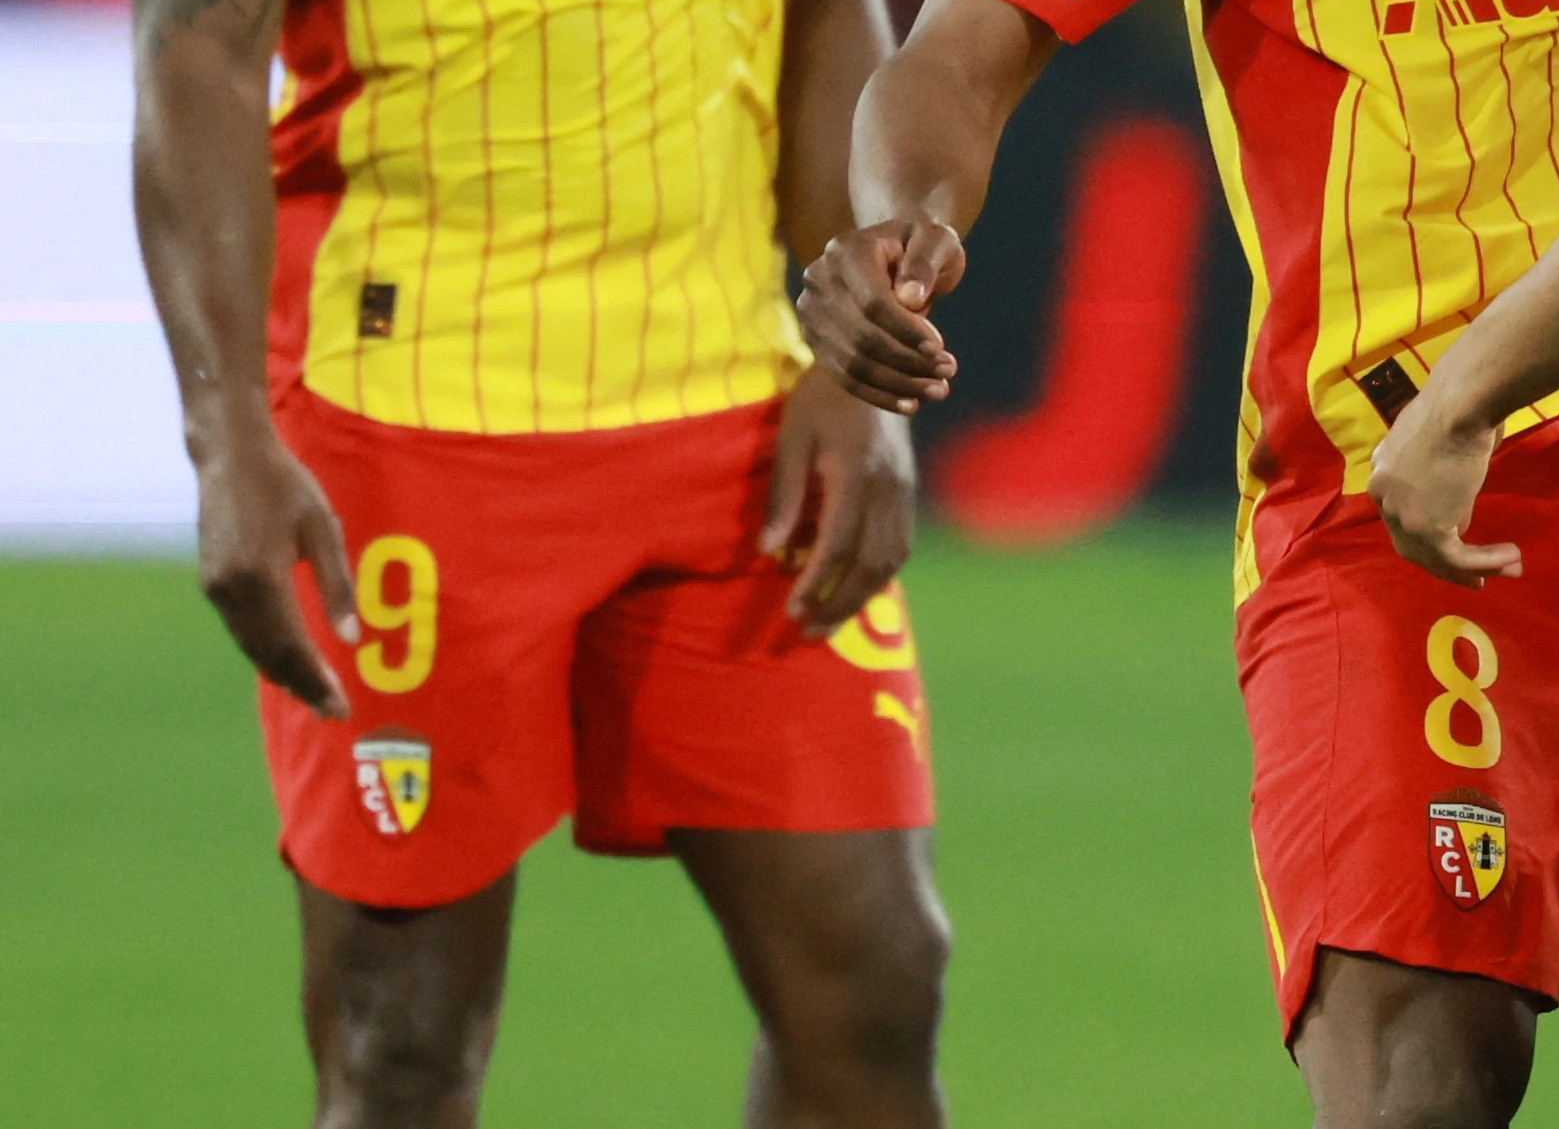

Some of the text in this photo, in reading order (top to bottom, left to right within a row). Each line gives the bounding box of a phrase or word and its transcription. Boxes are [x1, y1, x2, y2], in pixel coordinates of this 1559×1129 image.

[355, 534, 438, 694] 9
[1424, 614, 1502, 770] 8
[1435, 825, 1472, 899] RCL
[1458, 811, 1476, 821] CLUB
